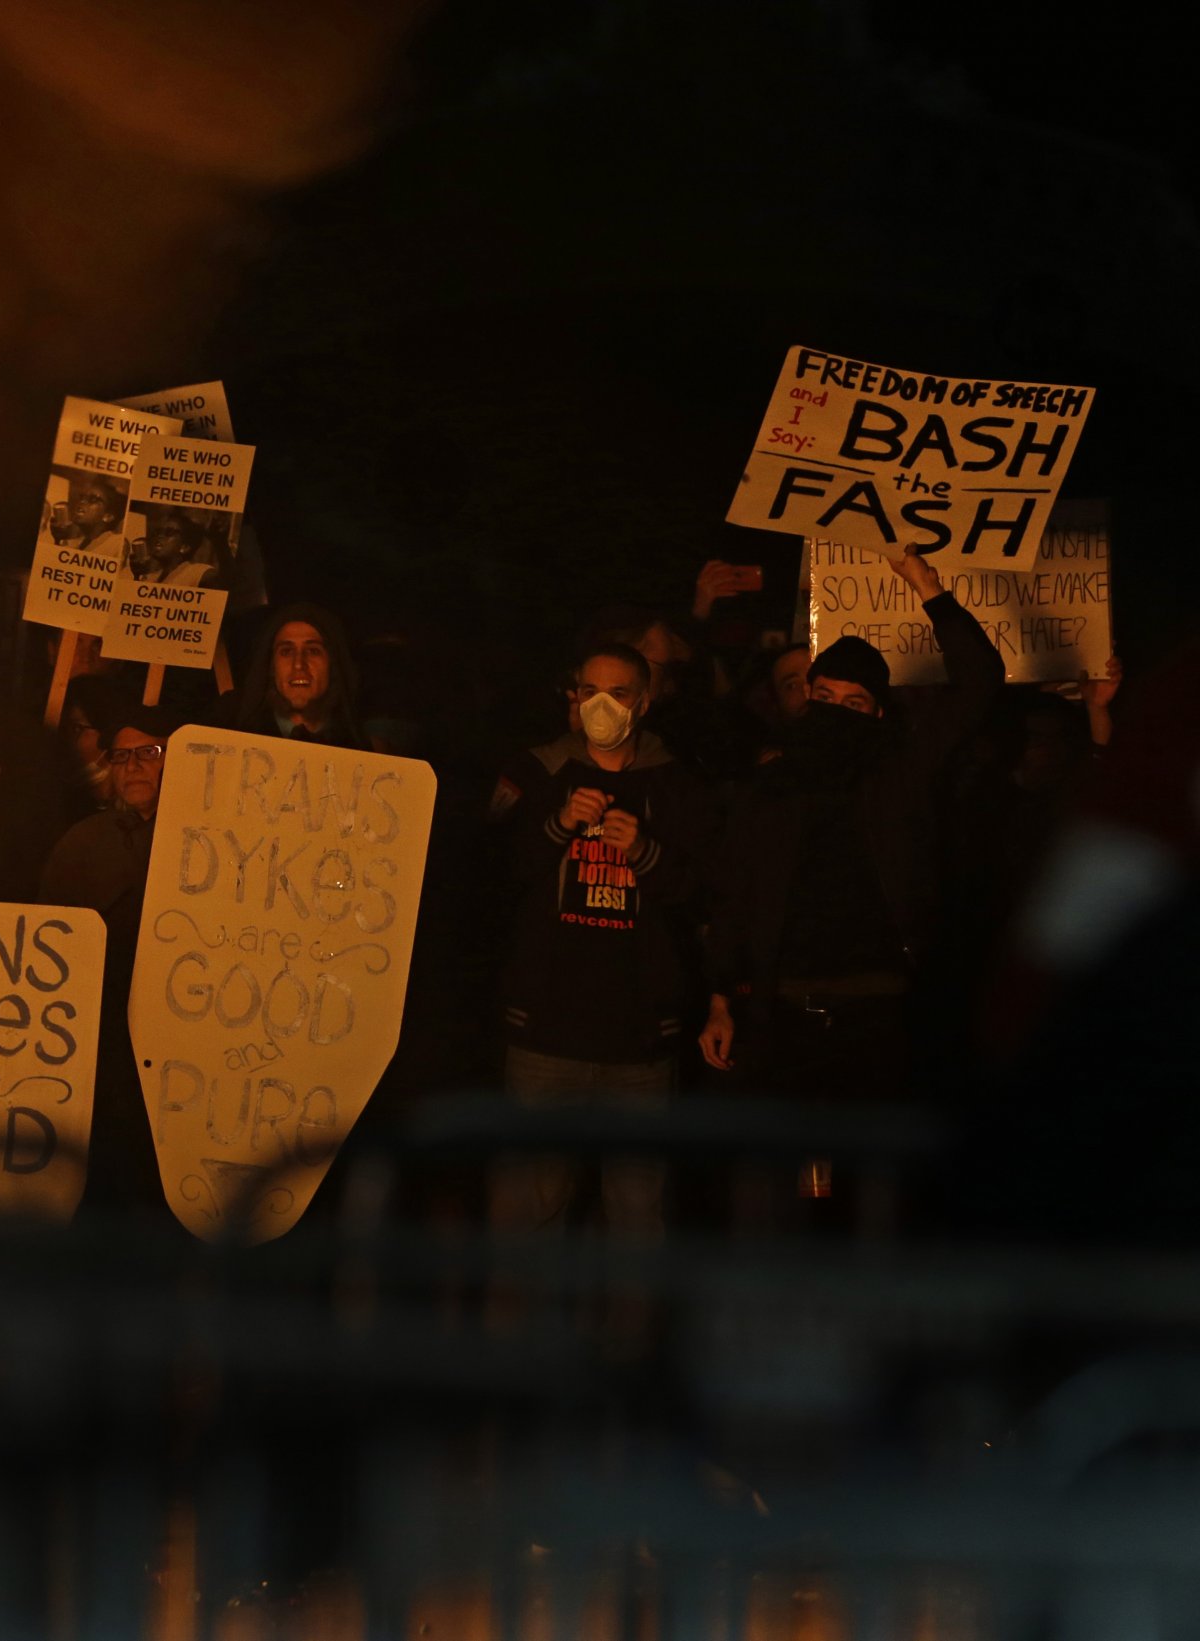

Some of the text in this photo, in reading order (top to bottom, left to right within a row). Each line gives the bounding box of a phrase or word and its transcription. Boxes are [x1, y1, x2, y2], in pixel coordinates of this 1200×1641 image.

[796, 349, 1088, 418] FREEDOM OF SPEECH
[165, 396, 205, 415] WHO
[789, 386, 829, 408] and
[88, 413, 115, 430] WE
[788, 406, 801, 426] I
[71, 430, 140, 457] BELIEVE
[838, 400, 1070, 478] BASH
[163, 446, 232, 467] WE WHO
[147, 465, 235, 488] BELIEVE IN
[892, 473, 952, 499] the
[149, 486, 230, 508] FREEDOM
[768, 467, 1037, 557] FASH
[41, 566, 86, 587] REST
[48, 587, 64, 601] IT
[137, 585, 206, 604] CANNOT
[822, 575, 859, 613] SO
[1014, 572, 1051, 608] WE
[1052, 571, 1109, 605] MAKE
[120, 602, 212, 625] REST UNTIL
[125, 623, 203, 643] IT COMES
[1020, 616, 1087, 653] HATE?
[185, 743, 403, 845] TRANS
[585, 886, 626, 911] LESS!
[238, 926, 303, 961] are
[164, 951, 356, 1047] GOOD
[224, 1034, 285, 1071] and
